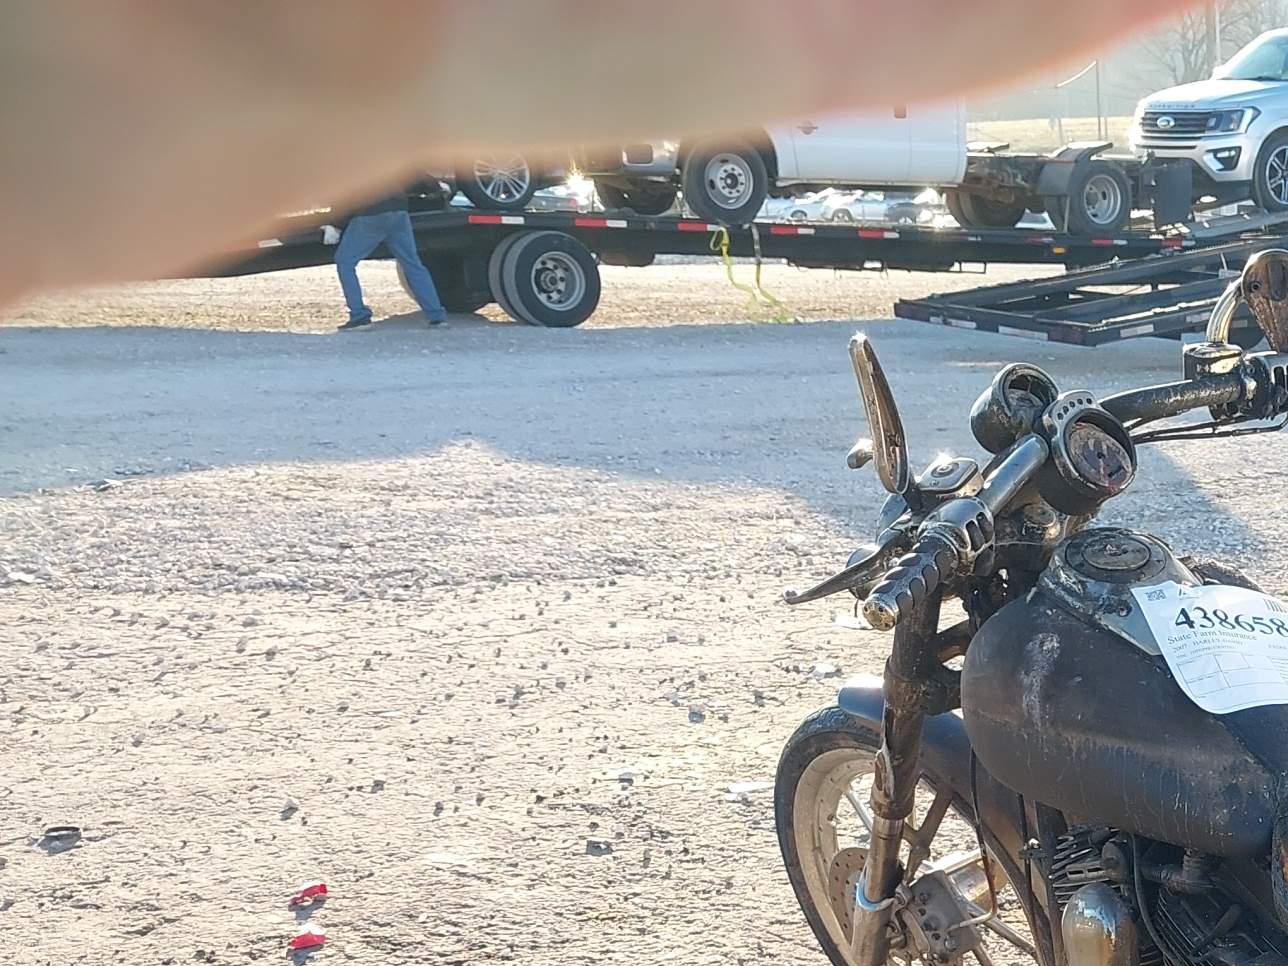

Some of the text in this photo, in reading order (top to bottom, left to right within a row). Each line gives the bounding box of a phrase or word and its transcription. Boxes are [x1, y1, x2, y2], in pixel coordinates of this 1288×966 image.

[1167, 630, 1257, 645] State Farm Insurance
